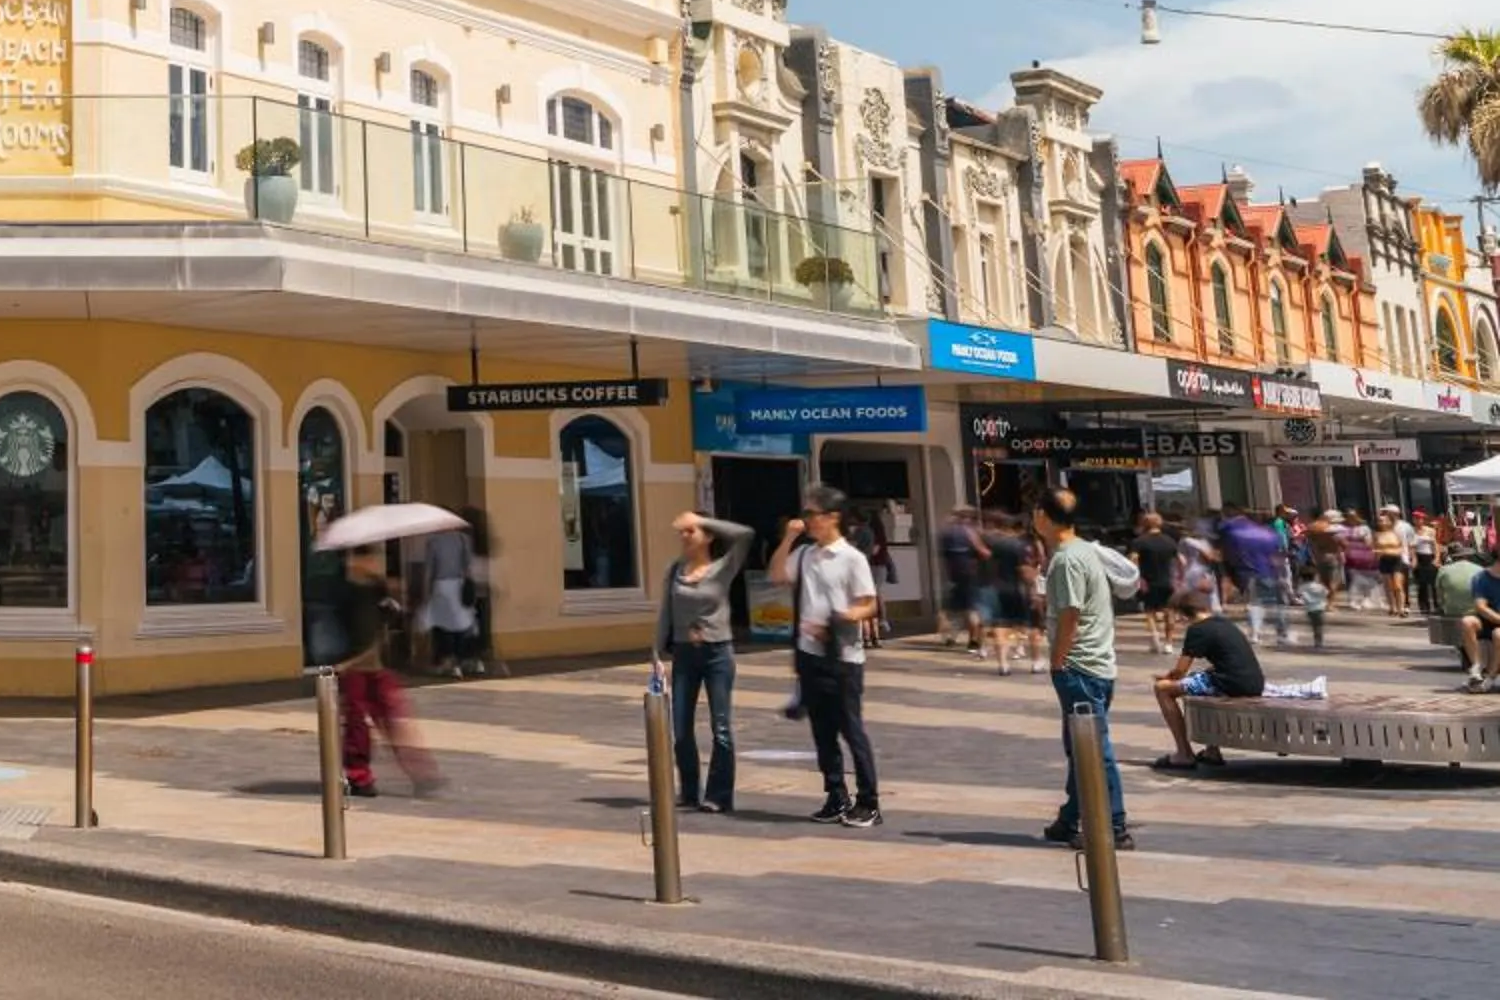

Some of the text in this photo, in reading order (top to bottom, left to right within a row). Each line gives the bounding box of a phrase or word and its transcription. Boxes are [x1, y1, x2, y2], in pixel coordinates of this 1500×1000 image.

[468, 385, 638, 405] STARBUCKS COFFEE
[751, 406, 908, 421] MANLY OCEAN FOODS
[1011, 437, 1072, 452] oporto
[1143, 432, 1235, 455] EBABS
